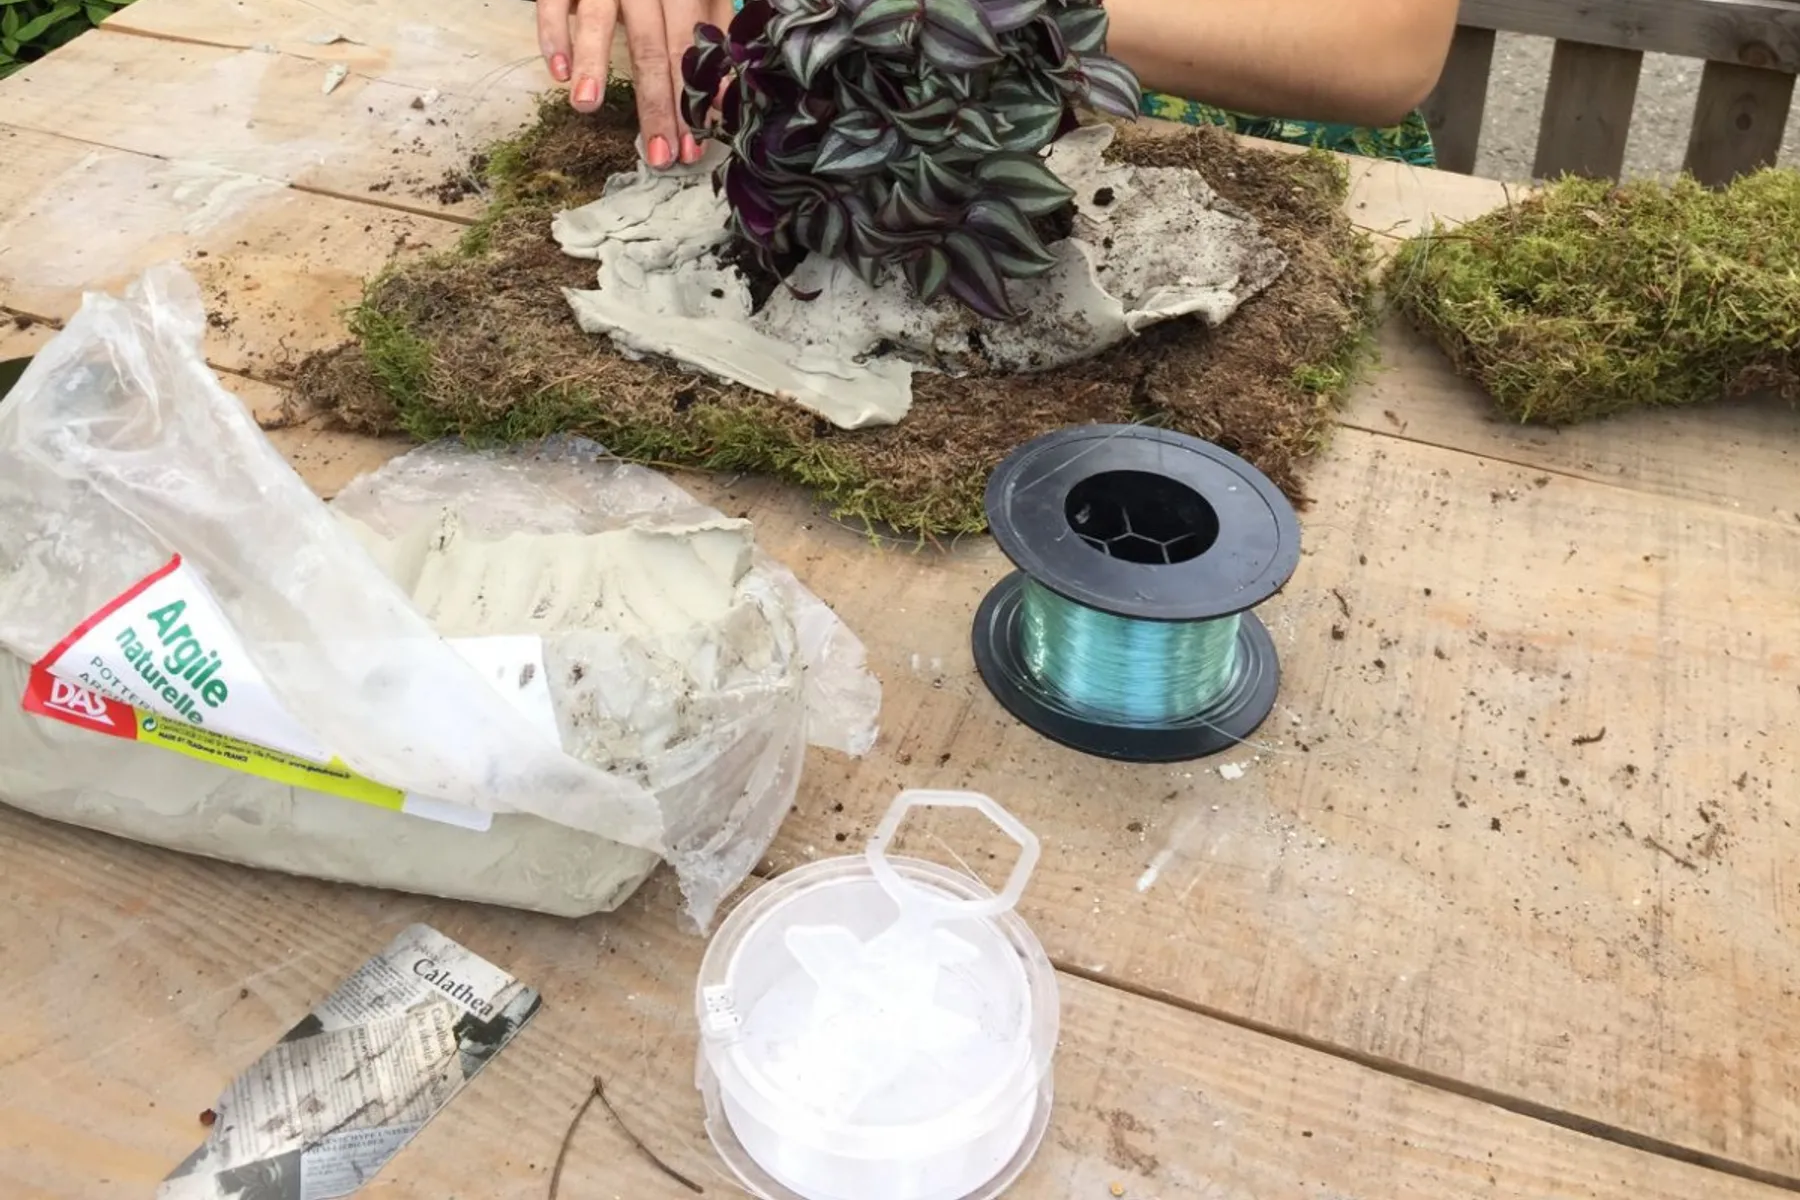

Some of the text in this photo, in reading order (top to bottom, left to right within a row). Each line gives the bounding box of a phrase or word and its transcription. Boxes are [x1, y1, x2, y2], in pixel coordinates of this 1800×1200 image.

[115, 626, 203, 724] naturelle
[147, 599, 228, 708] Argile
[51, 677, 107, 716] DAS
[412, 958, 494, 1016] Calathea
